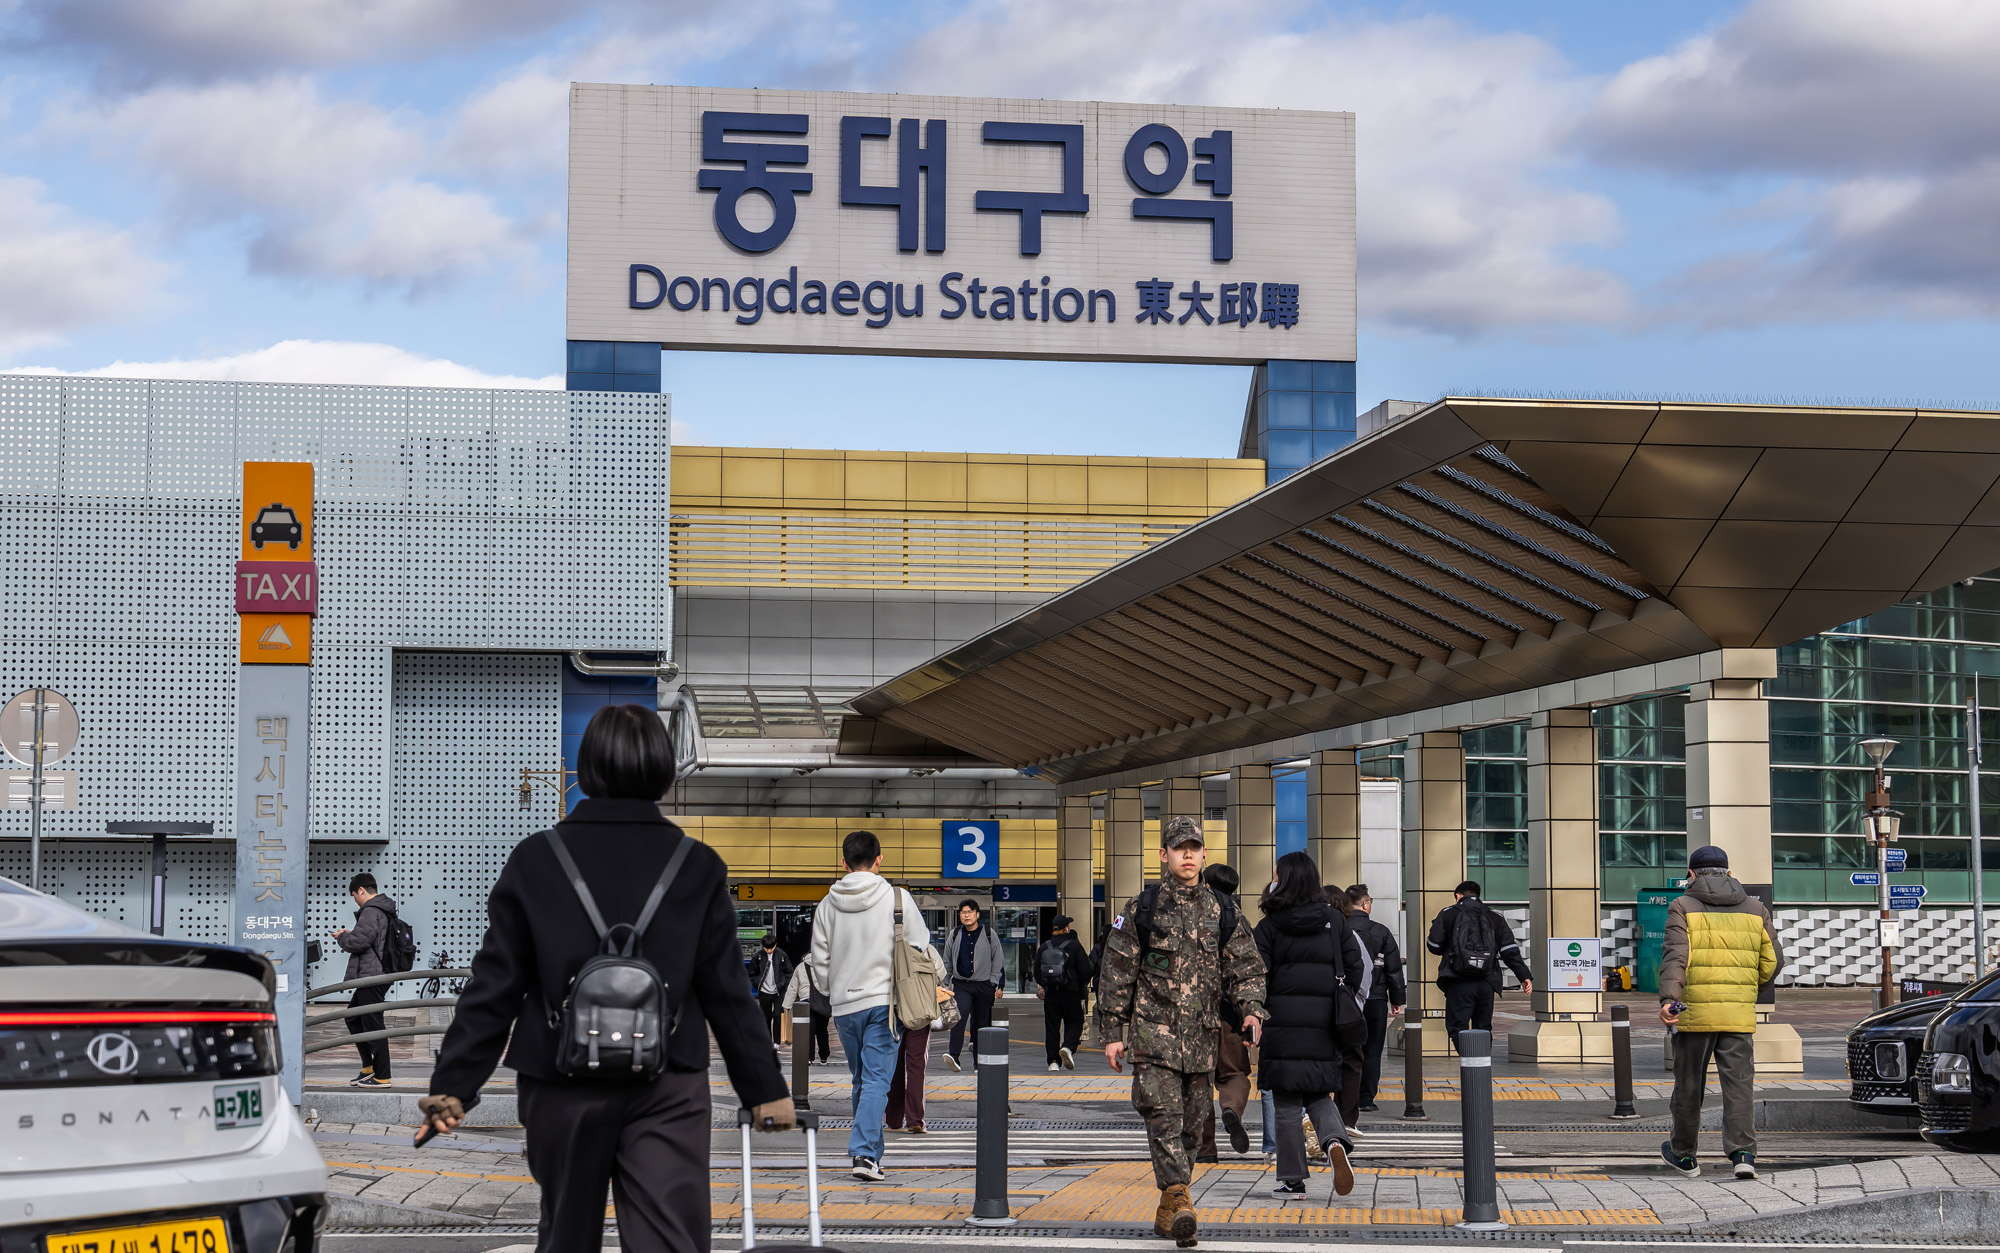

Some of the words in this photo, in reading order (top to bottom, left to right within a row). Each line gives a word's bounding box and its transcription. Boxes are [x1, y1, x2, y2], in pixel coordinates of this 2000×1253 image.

[699, 111, 1233, 261] 동대구역
[629, 263, 924, 327] Dongdaegu
[940, 273, 1116, 322] Station
[1136, 278, 1299, 328] 東大邱驛
[240, 573, 311, 600] TAXI
[957, 827, 986, 873] 3
[747, 886, 755, 898] 3
[1002, 887, 1010, 899] 3
[245, 916, 293, 929] 동대구역
[242, 932, 281, 940] Dongdaegu
[1553, 959, 1577, 967] 흡연구역
[1578, 959, 1597, 967] 가는길
[18, 1105, 211, 1129] SONATA
